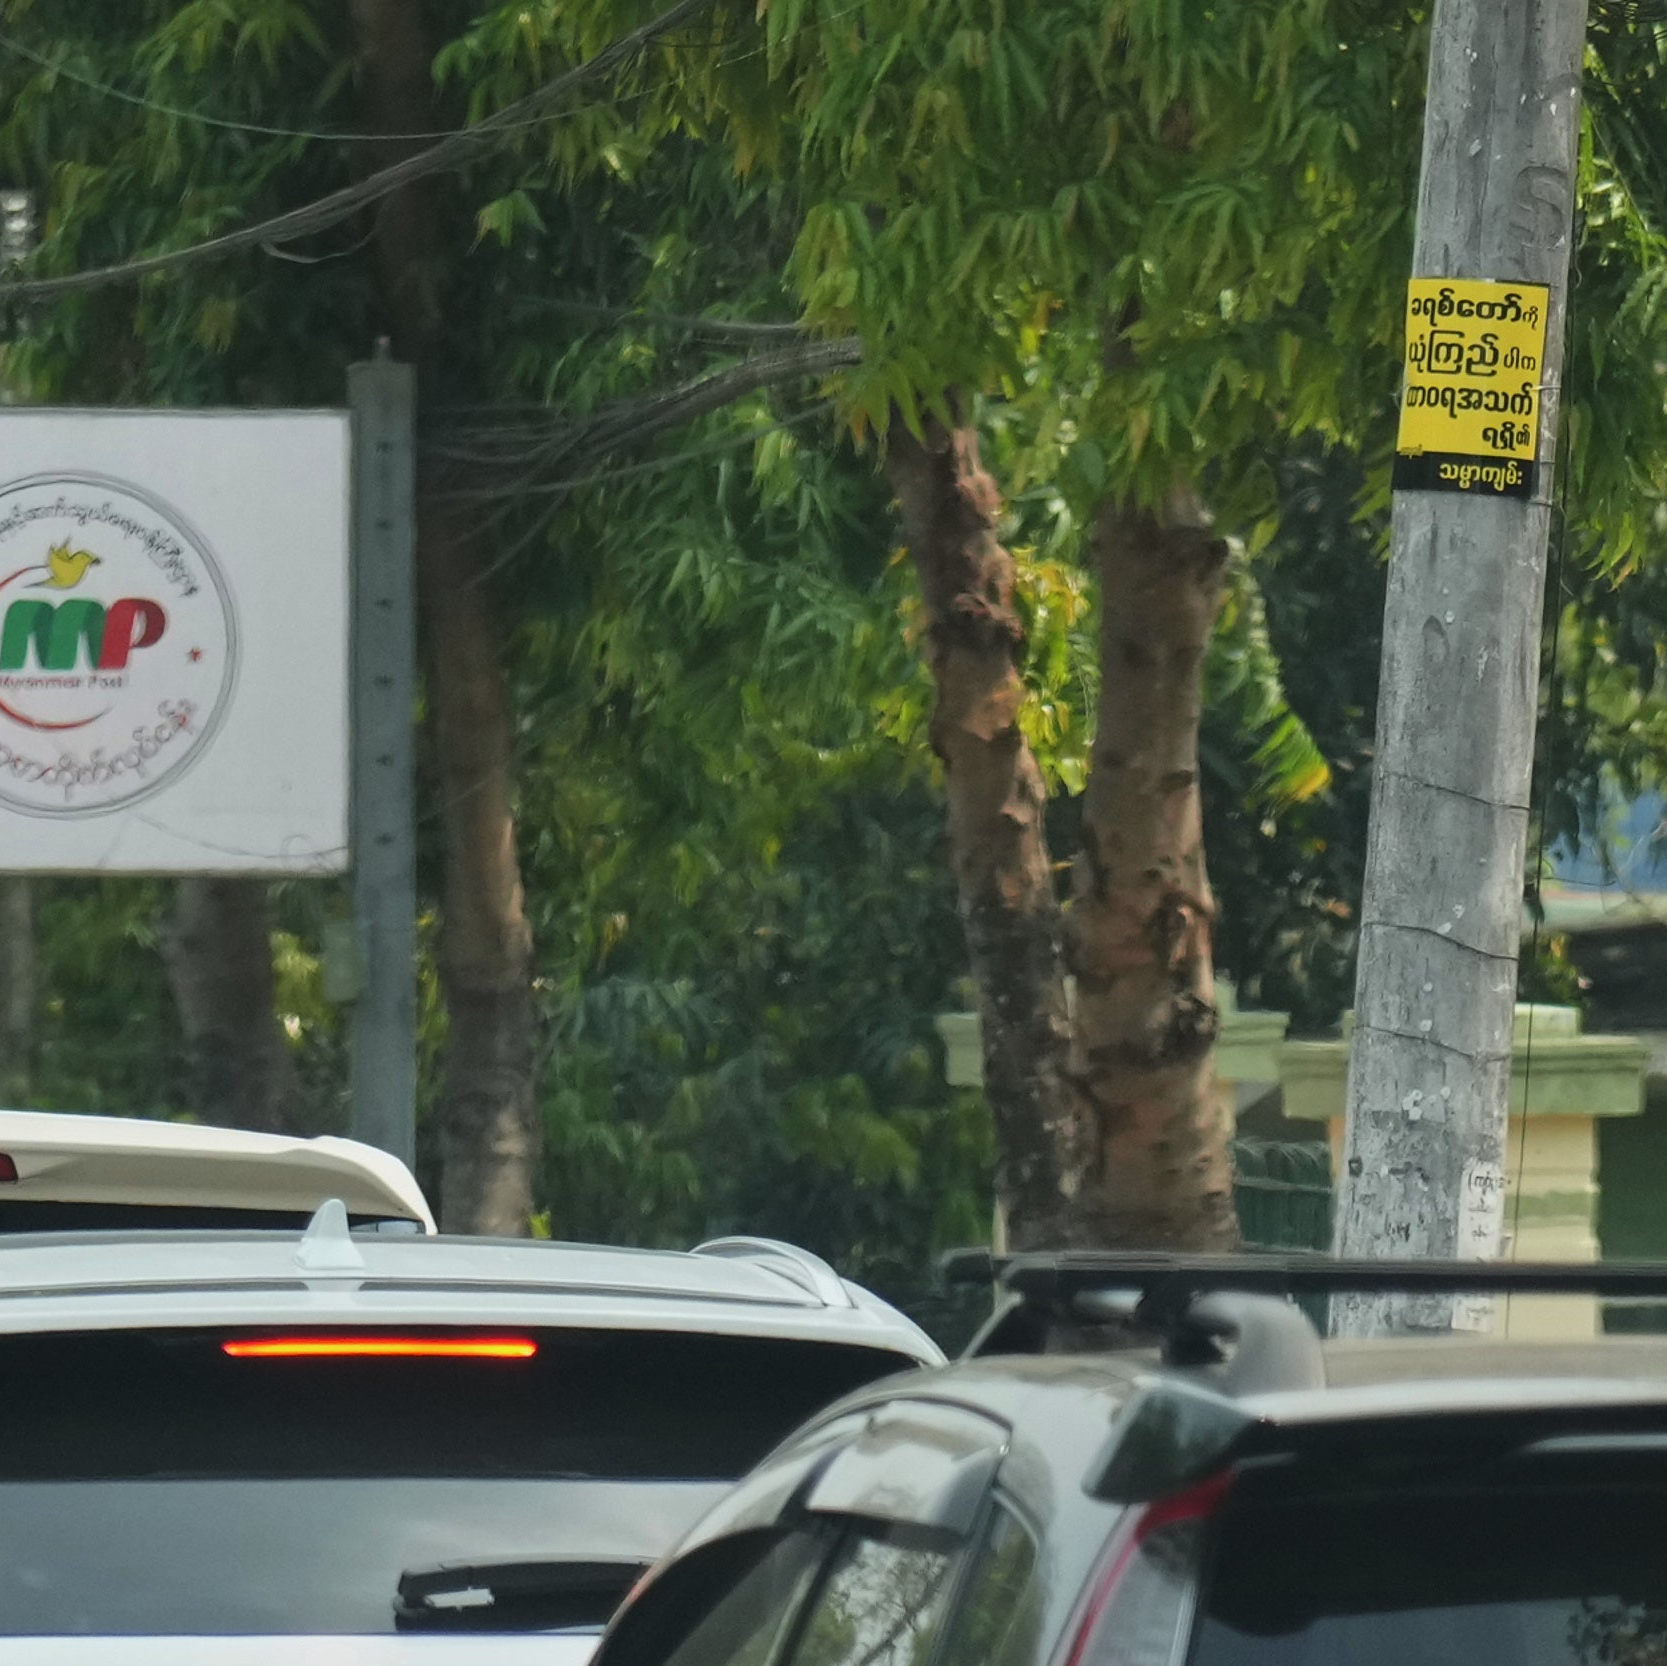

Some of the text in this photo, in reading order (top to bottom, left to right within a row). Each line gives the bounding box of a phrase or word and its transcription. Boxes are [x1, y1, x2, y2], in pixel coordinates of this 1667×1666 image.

[1410, 287, 1539, 331] ခရစ်တော်ကို
[1439, 460, 1524, 491] သမ္မာကျမ်း
